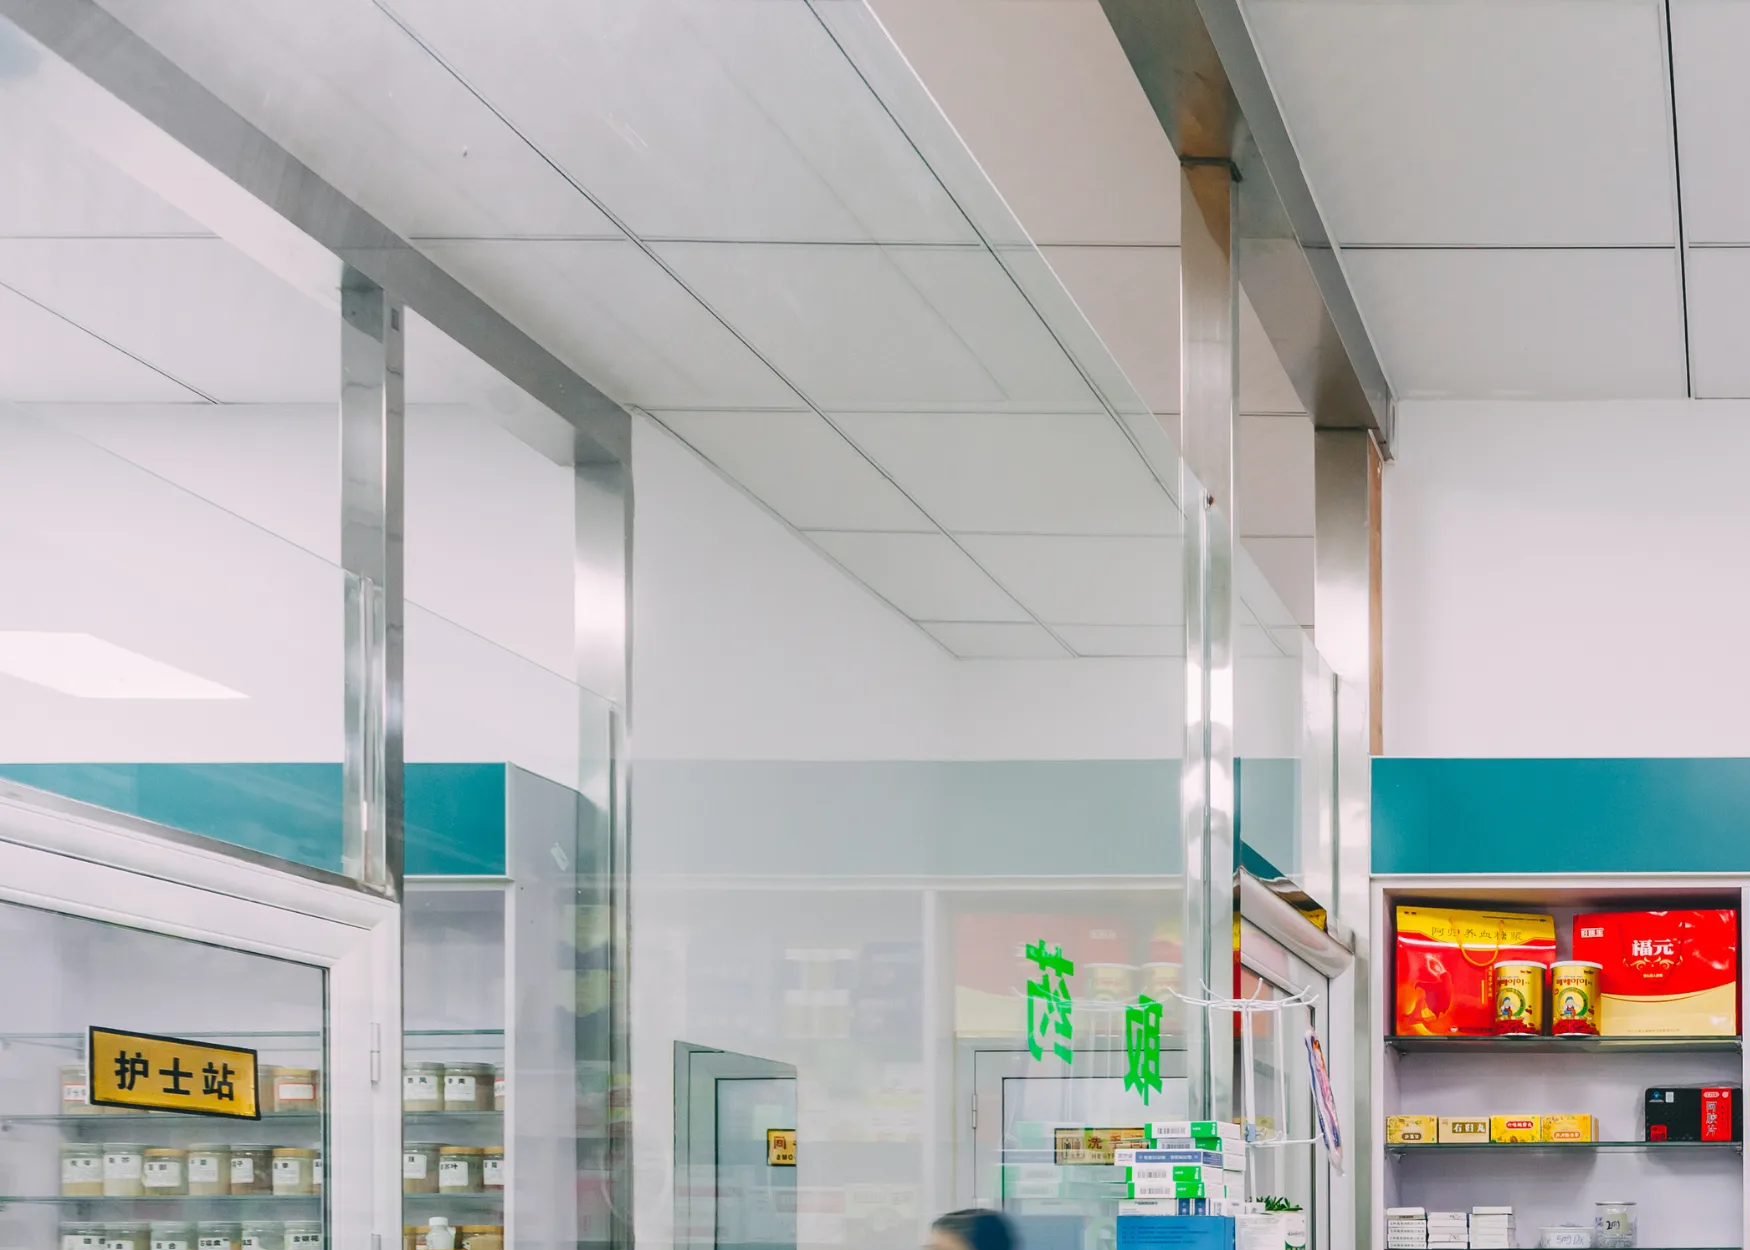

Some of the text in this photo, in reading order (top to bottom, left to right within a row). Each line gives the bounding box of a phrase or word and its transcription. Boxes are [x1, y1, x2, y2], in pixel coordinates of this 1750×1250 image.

[1632, 938, 1674, 957] 福元
[113, 1050, 236, 1102] 护士站
[1706, 1101, 1718, 1137] 阿胶片
